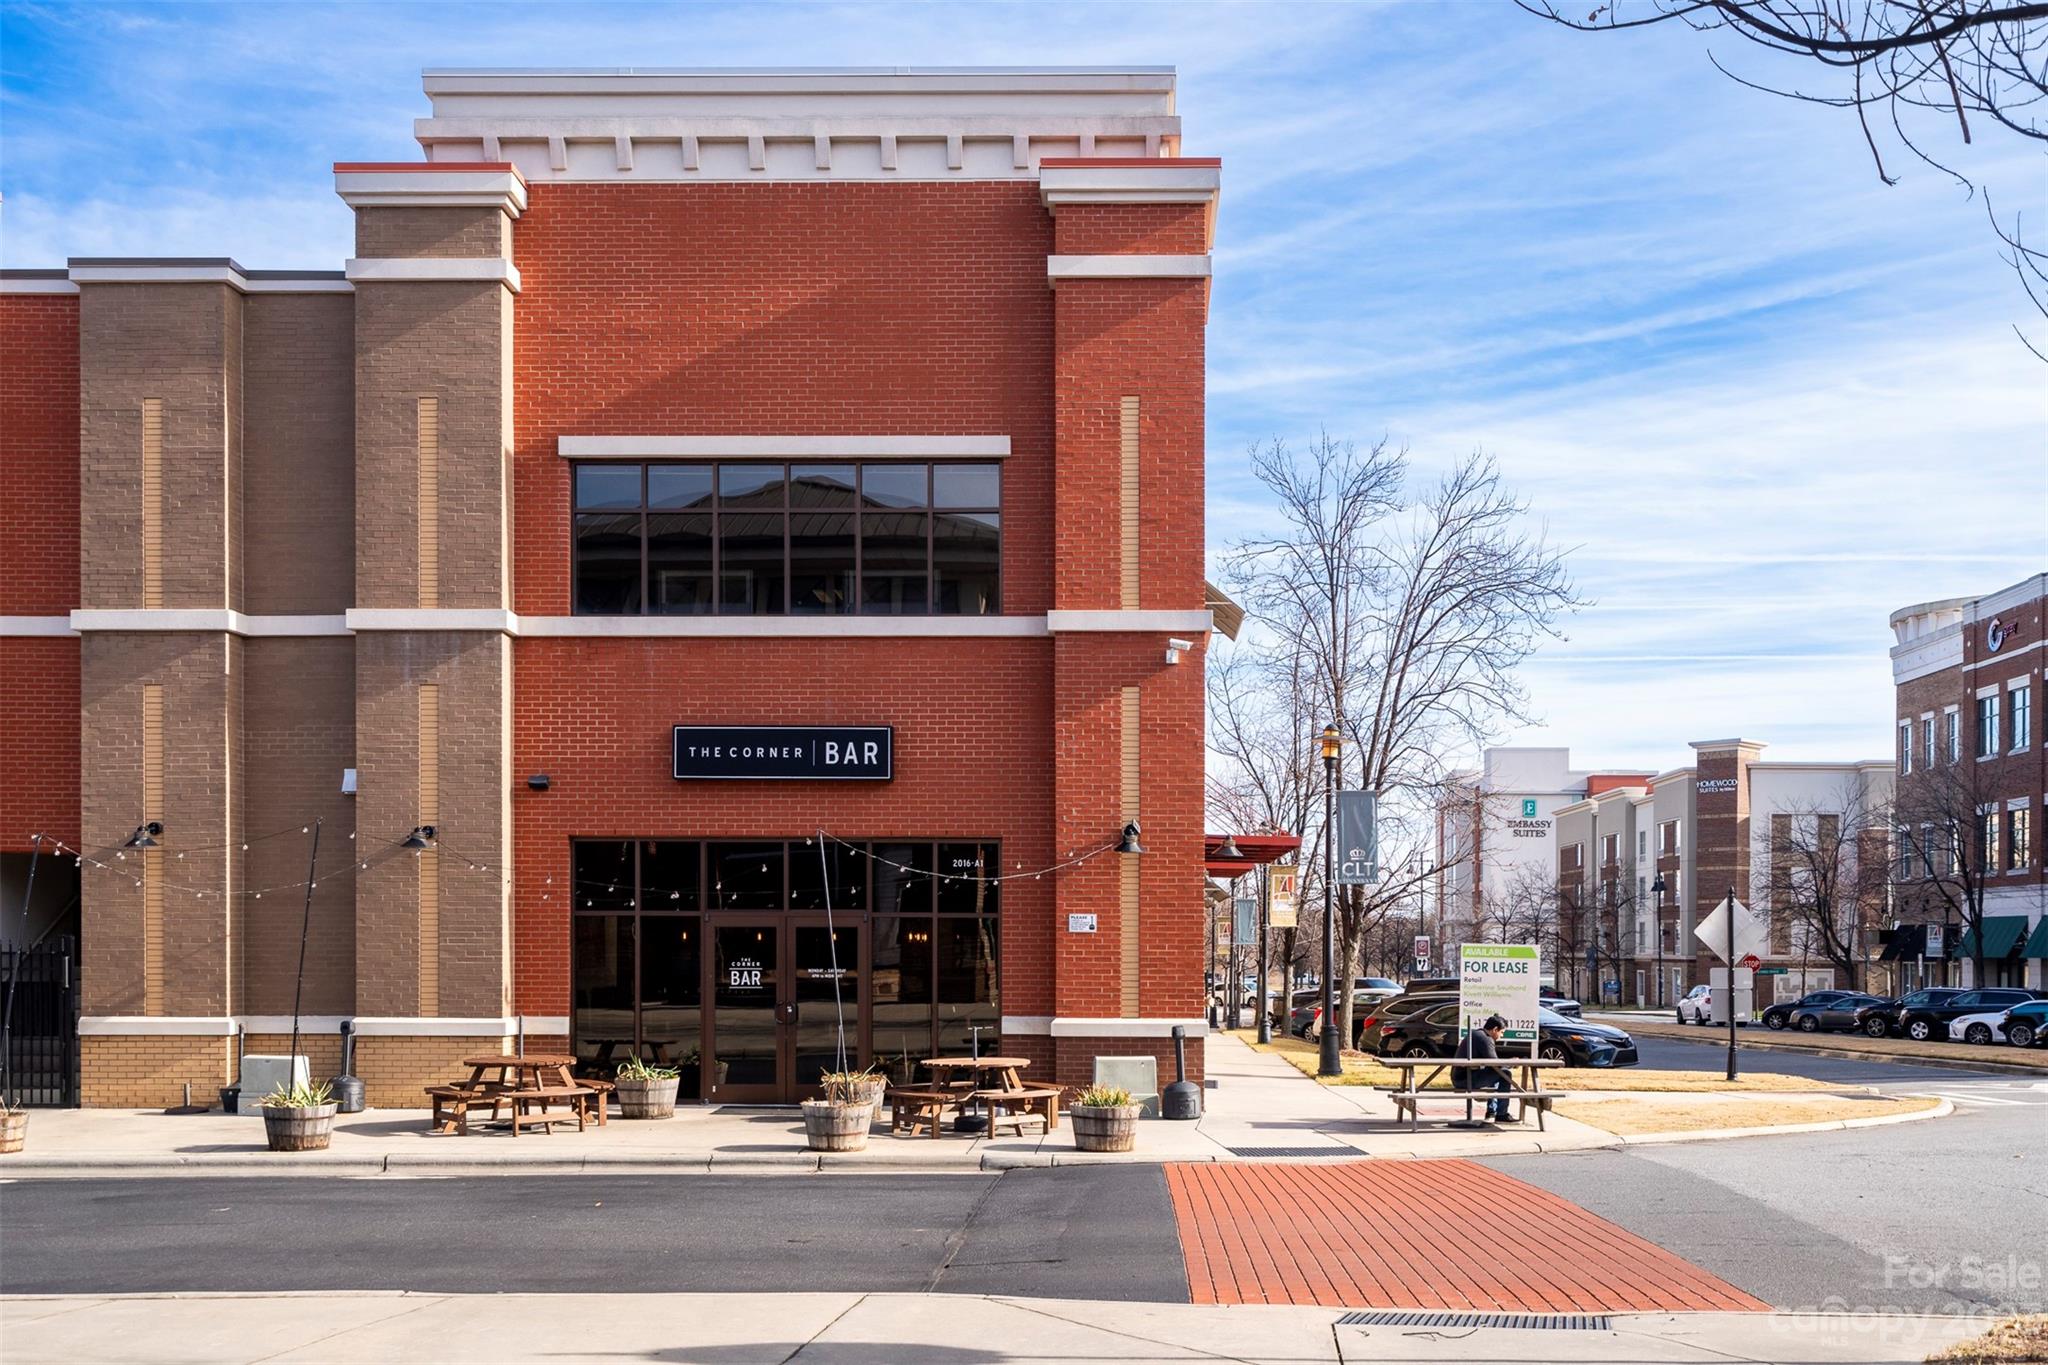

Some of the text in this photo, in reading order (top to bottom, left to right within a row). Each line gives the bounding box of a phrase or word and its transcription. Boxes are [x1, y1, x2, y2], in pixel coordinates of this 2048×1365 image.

[689, 741, 879, 765] THE CORNER BAR
[1696, 778, 1738, 788] HOMEWOOD
[1507, 820, 1552, 828] EMBASSY
[1513, 829, 1546, 837] SUITES
[1342, 862, 1374, 877] CLT
[1464, 948, 1509, 956] AVAILABLE
[1464, 961, 1528, 974] FOR LEASE
[1744, 960, 1760, 968] STOP
[731, 970, 761, 986] BAR
[1516, 1019, 1535, 1029] 1222
